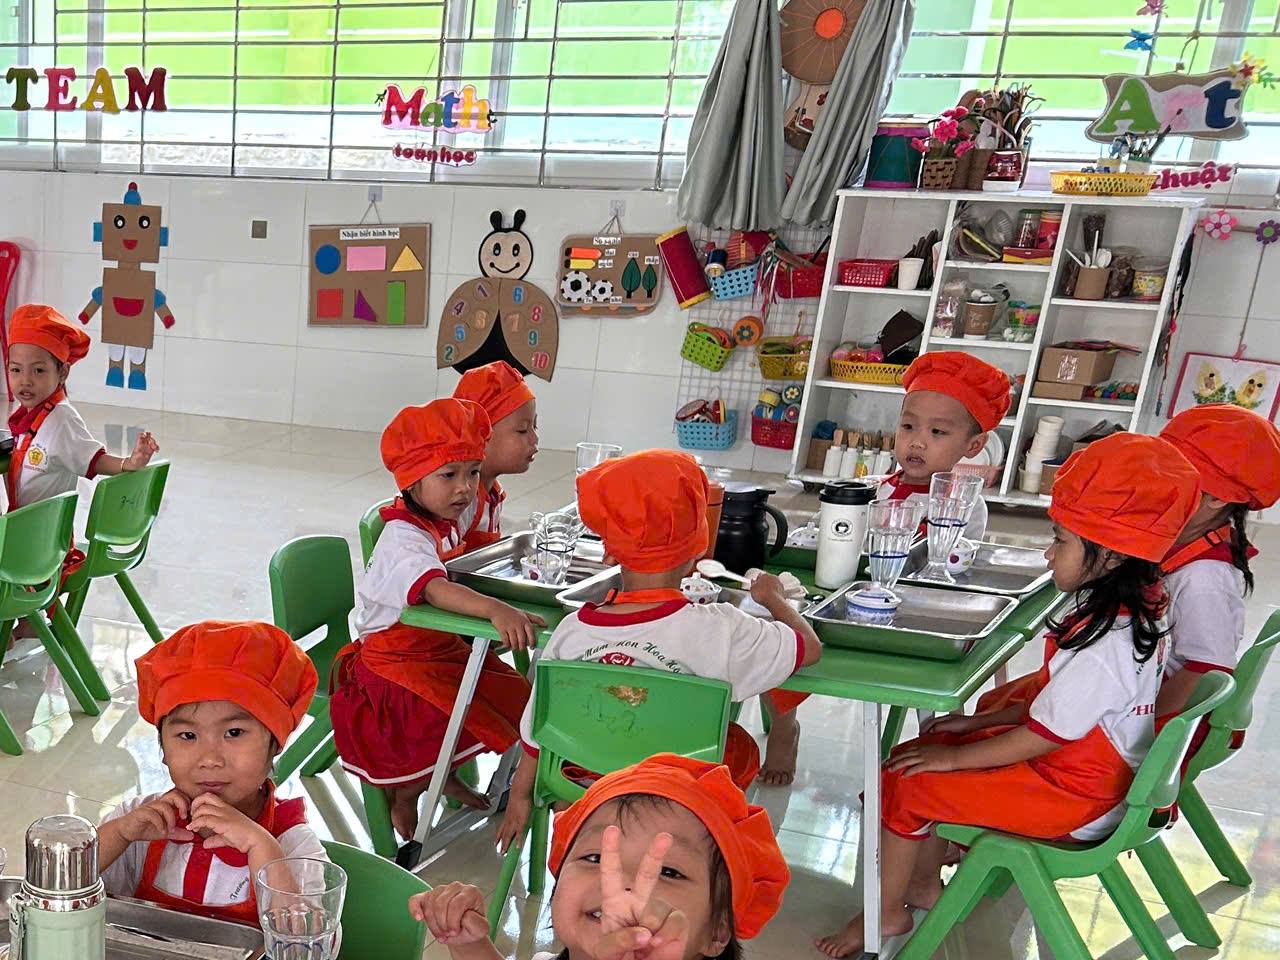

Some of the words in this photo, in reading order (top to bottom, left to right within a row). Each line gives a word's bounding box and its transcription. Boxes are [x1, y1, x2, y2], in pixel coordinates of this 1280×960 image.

[382, 85, 489, 130] Math
[1094, 78, 1243, 134] Art
[439, 146, 476, 167] học
[477, 284, 488, 298] 1
[512, 286, 524, 304] 6
[453, 300, 465, 316] 4
[531, 305, 543, 323] 8
[507, 313, 520, 333] 7
[454, 324, 466, 342] 5
[528, 330, 538, 346] 9
[444, 345, 454, 361] 2
[531, 352, 550, 369] 10
[642, 641, 665, 663] Hoa
